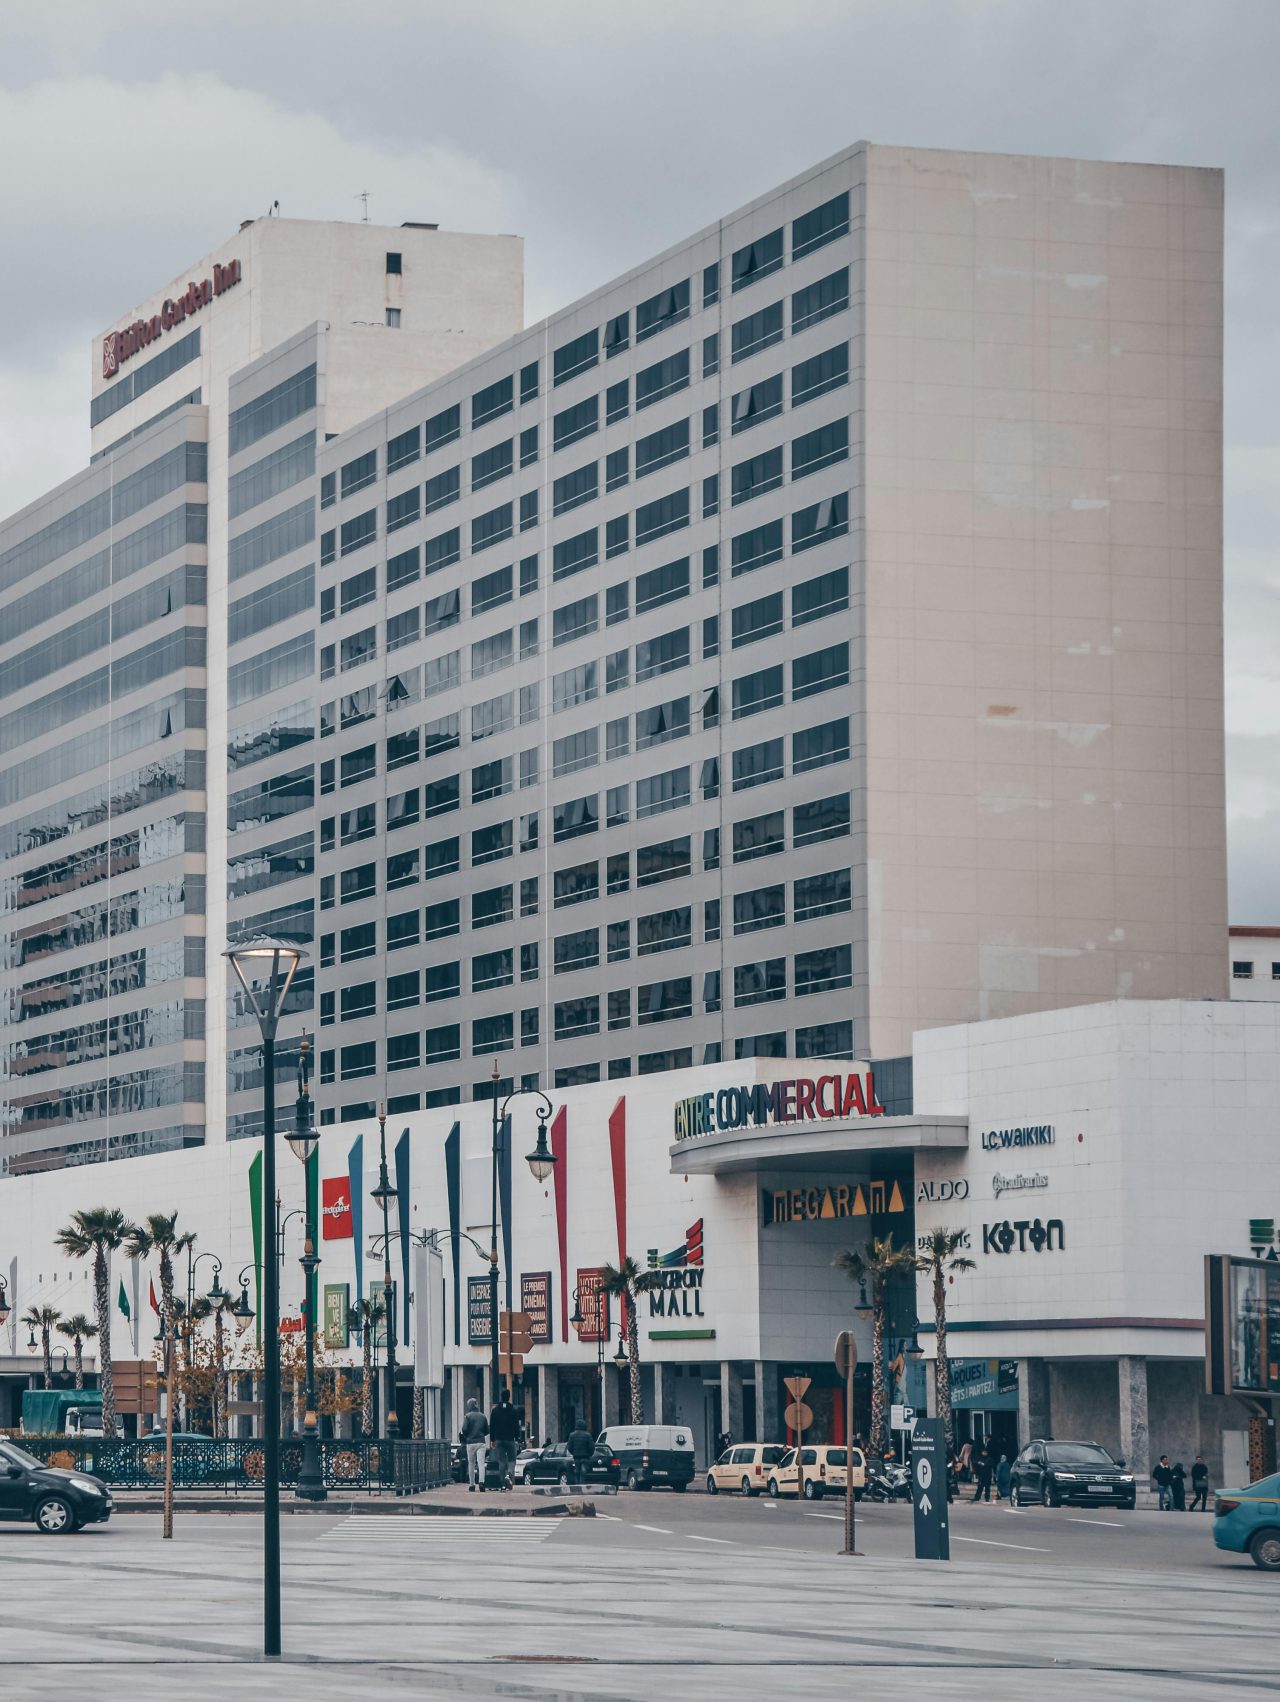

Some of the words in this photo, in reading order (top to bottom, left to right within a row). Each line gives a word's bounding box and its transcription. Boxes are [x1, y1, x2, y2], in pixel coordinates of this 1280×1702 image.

[674, 1092, 715, 1141] CENTRE
[716, 1072, 886, 1130] COMMERCIAL
[982, 1131, 998, 1150] LC
[773, 1179, 905, 1222] MEGARAMA
[918, 1178, 969, 1202] ALDO
[982, 1218, 1066, 1254] KOTON
[528, 1281, 546, 1291] PREMIER
[523, 1292, 546, 1308] CINÉMA
[649, 1289, 705, 1317] MALL
[950, 1363, 982, 1387] ARQUES
[968, 1381, 992, 1399] PARTEZ
[904, 1407, 914, 1419] P
